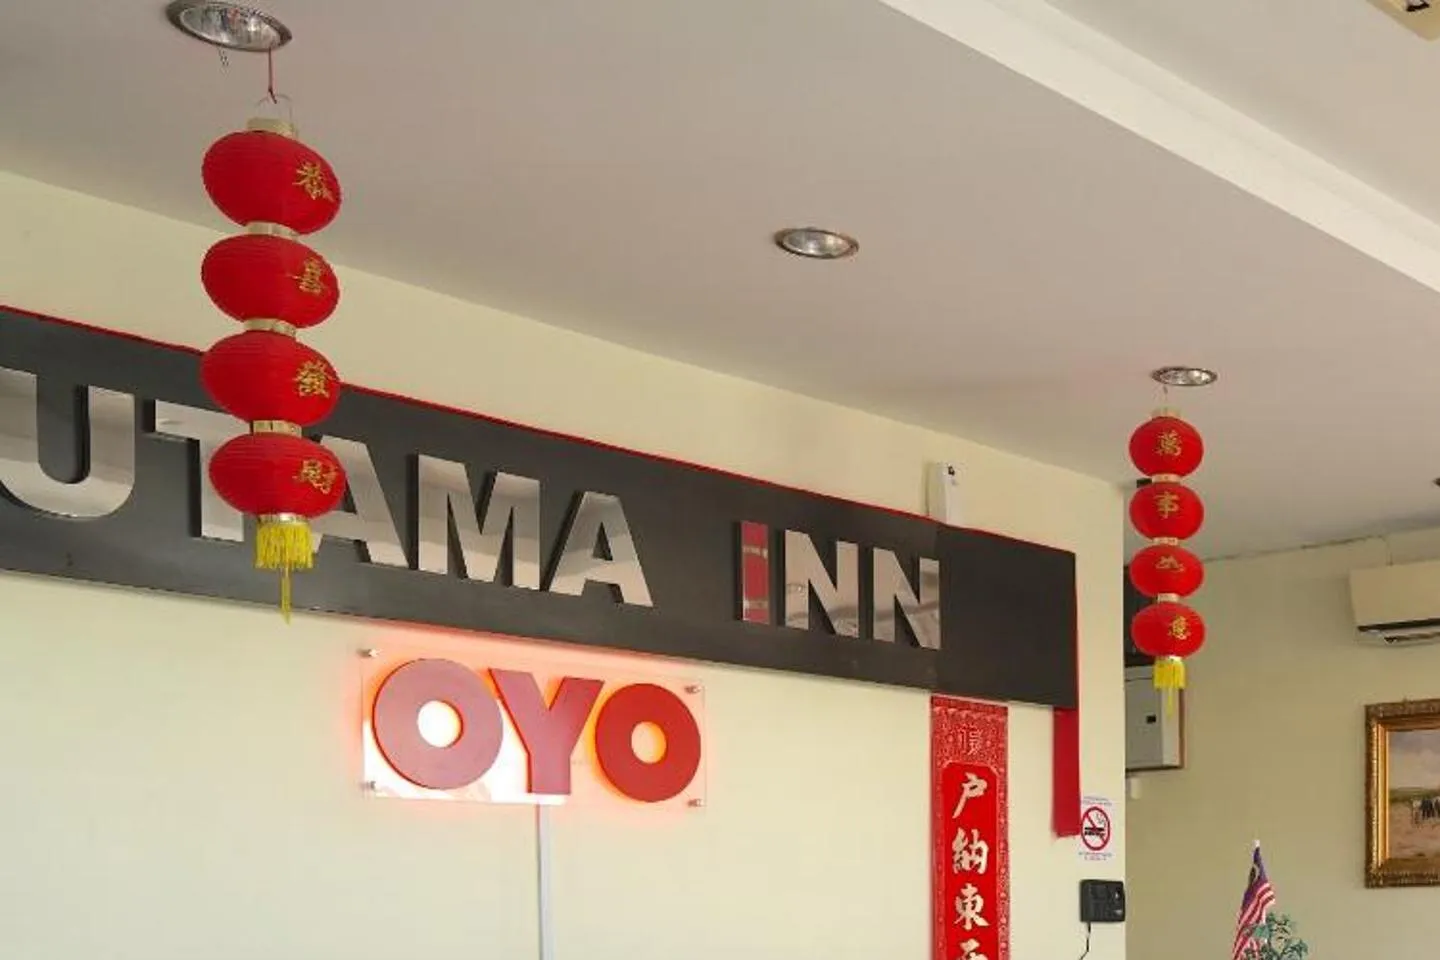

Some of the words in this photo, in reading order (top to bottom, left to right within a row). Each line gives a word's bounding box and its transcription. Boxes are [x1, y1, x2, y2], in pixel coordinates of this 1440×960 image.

[0, 364, 653, 608] UTAMA
[740, 519, 942, 651] INN
[371, 657, 701, 803] OYO
